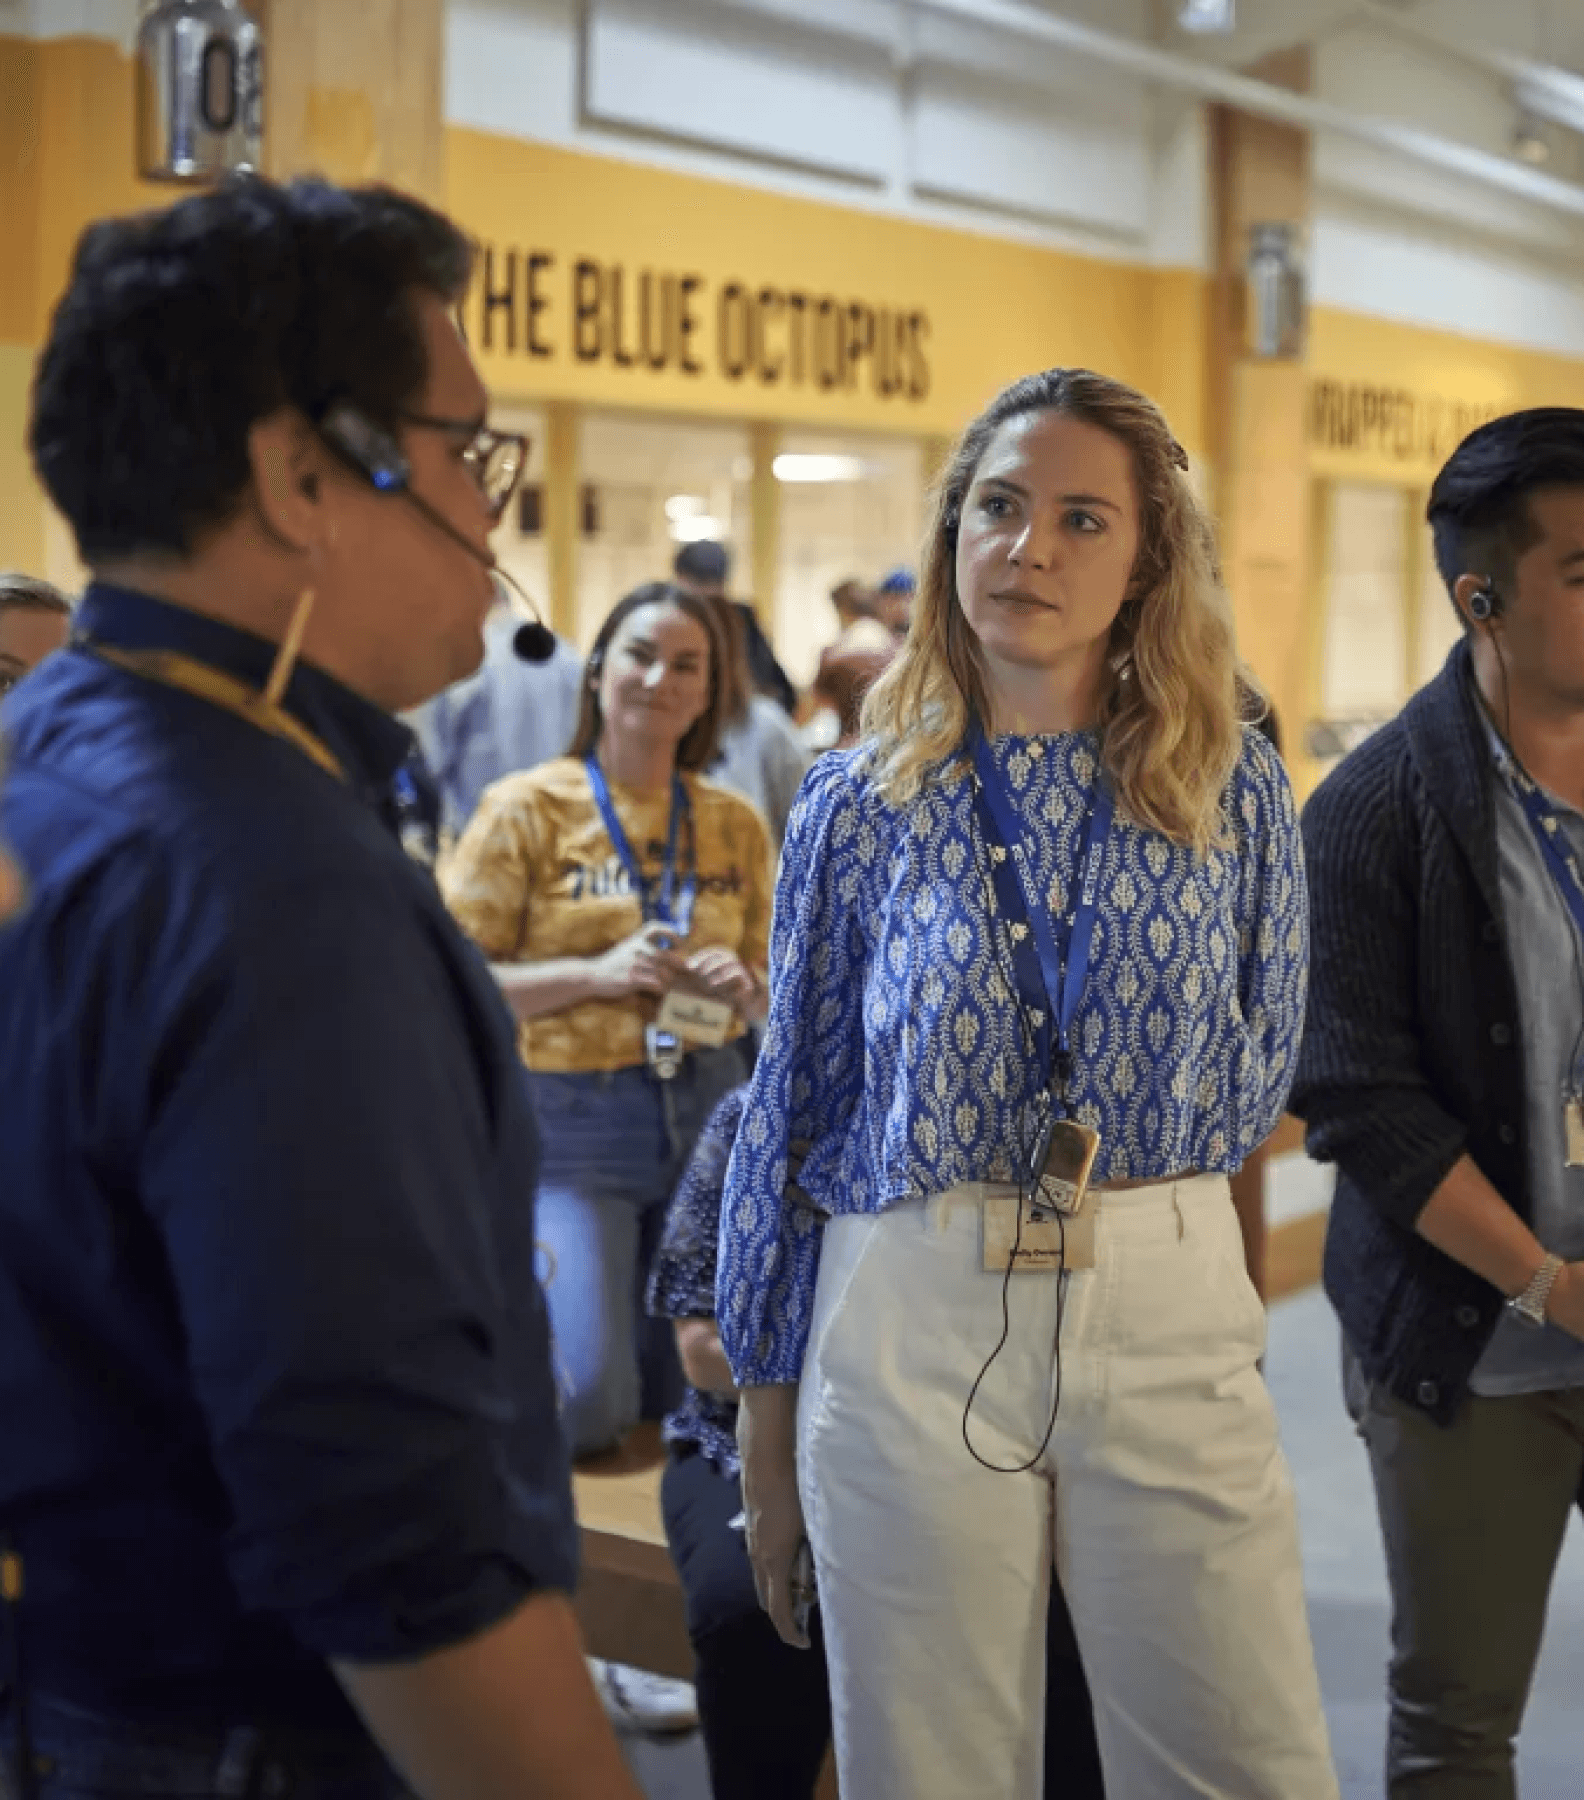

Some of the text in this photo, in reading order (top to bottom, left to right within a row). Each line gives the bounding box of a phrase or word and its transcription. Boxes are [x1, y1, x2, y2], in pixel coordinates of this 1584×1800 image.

[468, 242, 928, 400] HE BLUE OCTOPUS
